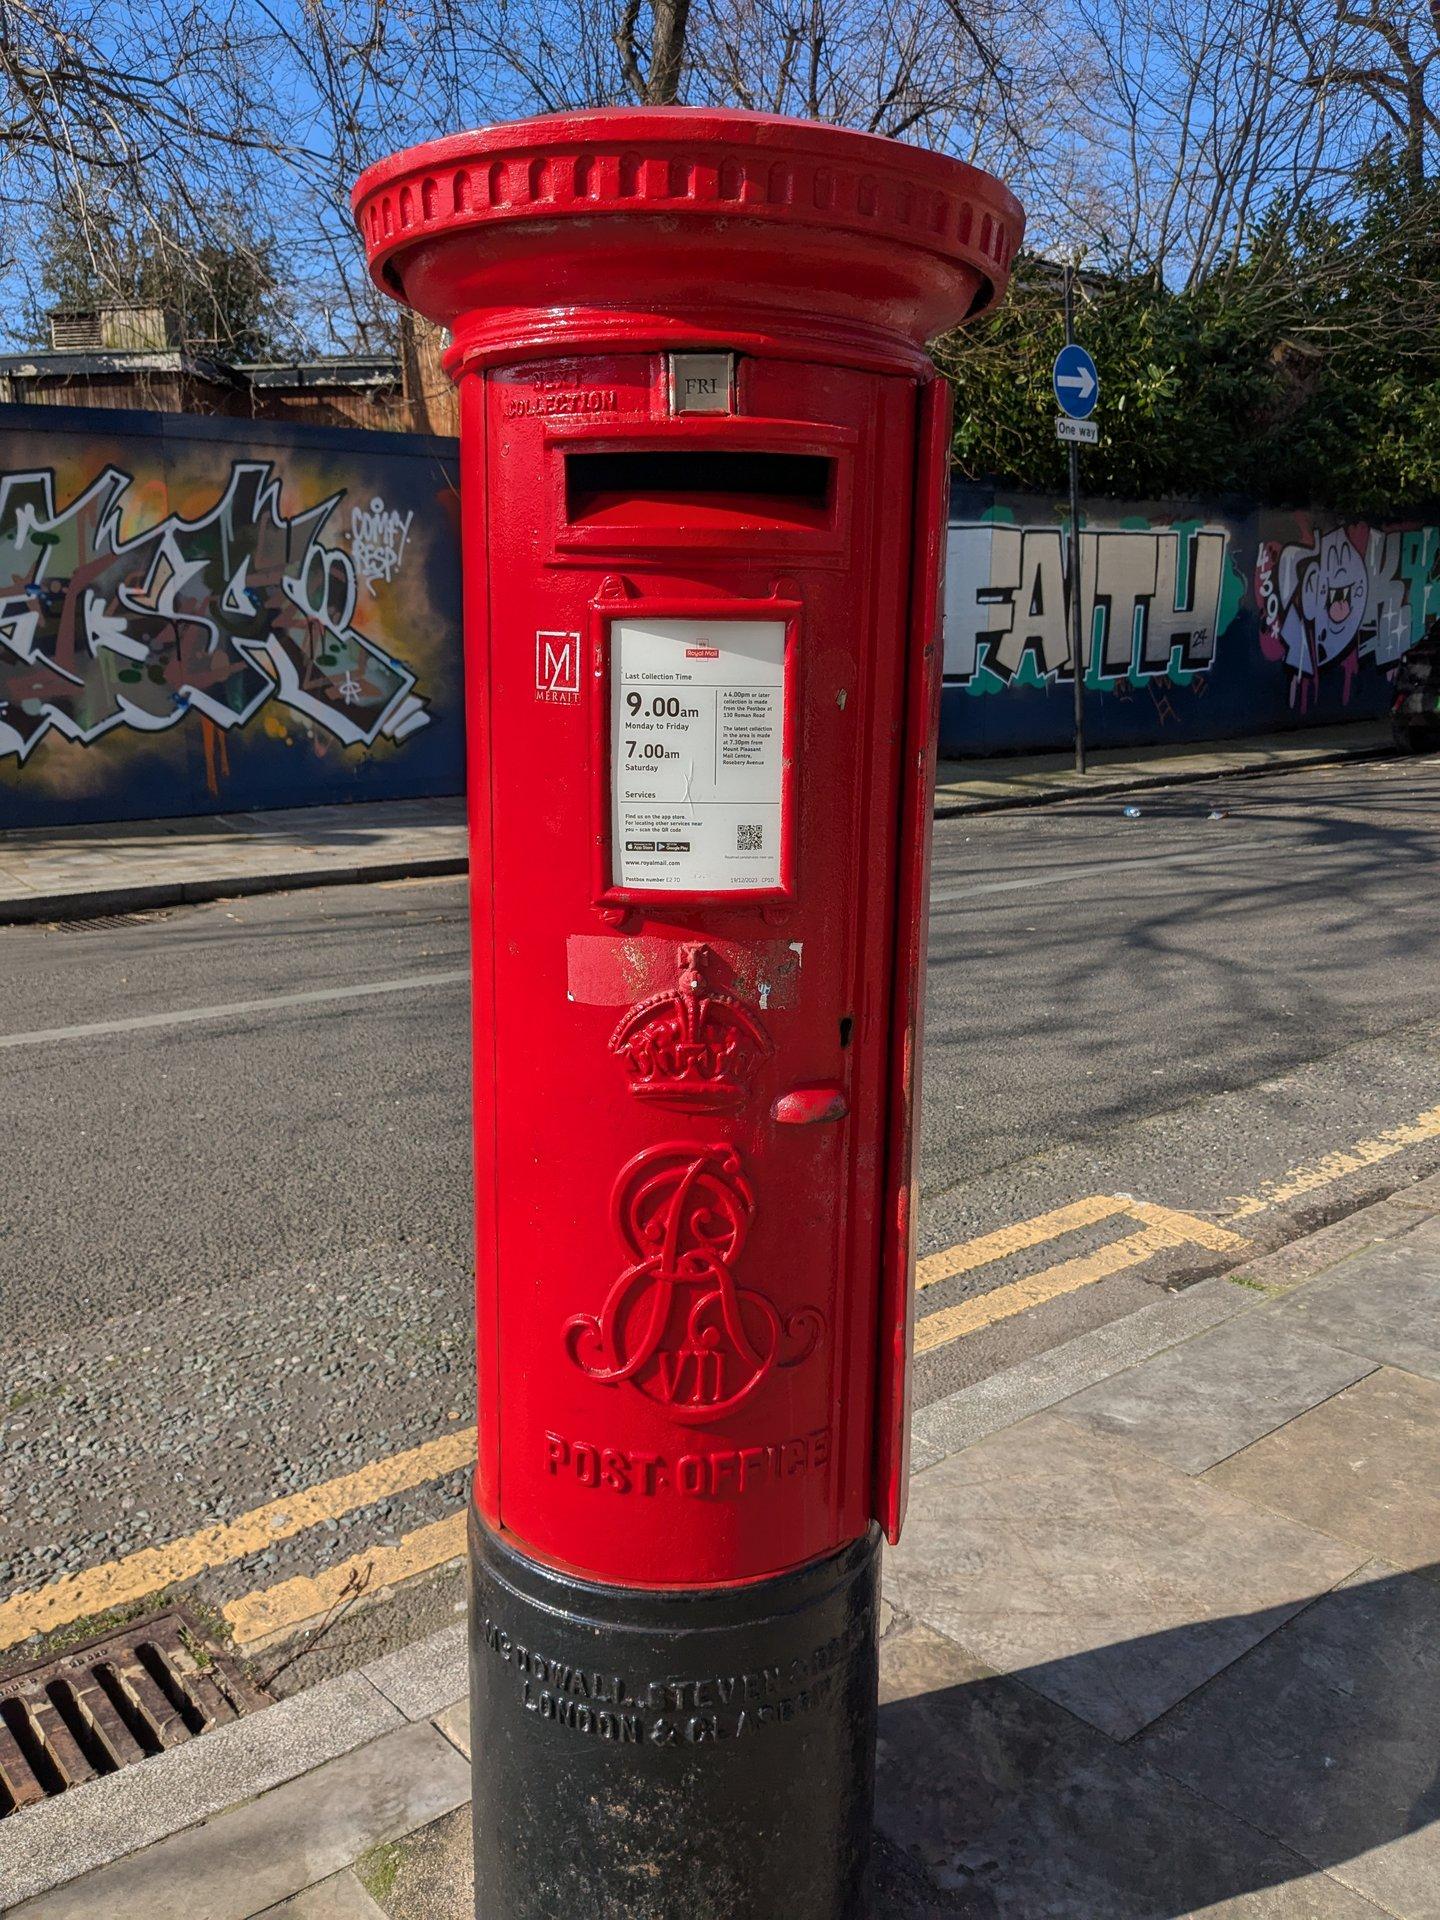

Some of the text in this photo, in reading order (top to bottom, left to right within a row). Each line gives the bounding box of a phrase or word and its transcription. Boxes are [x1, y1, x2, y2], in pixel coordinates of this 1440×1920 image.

[685, 378, 717, 394] FRI
[505, 390, 618, 417] COLLECTION
[1058, 421, 1095, 439] One way
[942, 524, 1227, 683] FAITH
[641, 672, 673, 680] Collection
[626, 691, 699, 717] 9.00am
[625, 722, 654, 730] Monday
[666, 722, 689, 731] Friday
[625, 740, 680, 758] 7.00am
[625, 763, 658, 772] Saturday
[625, 790, 656, 798] Services
[676, 1428, 829, 1495] OFFICE
[523, 1680, 638, 1744] LONDON
[650, 1717, 677, 1748] &
